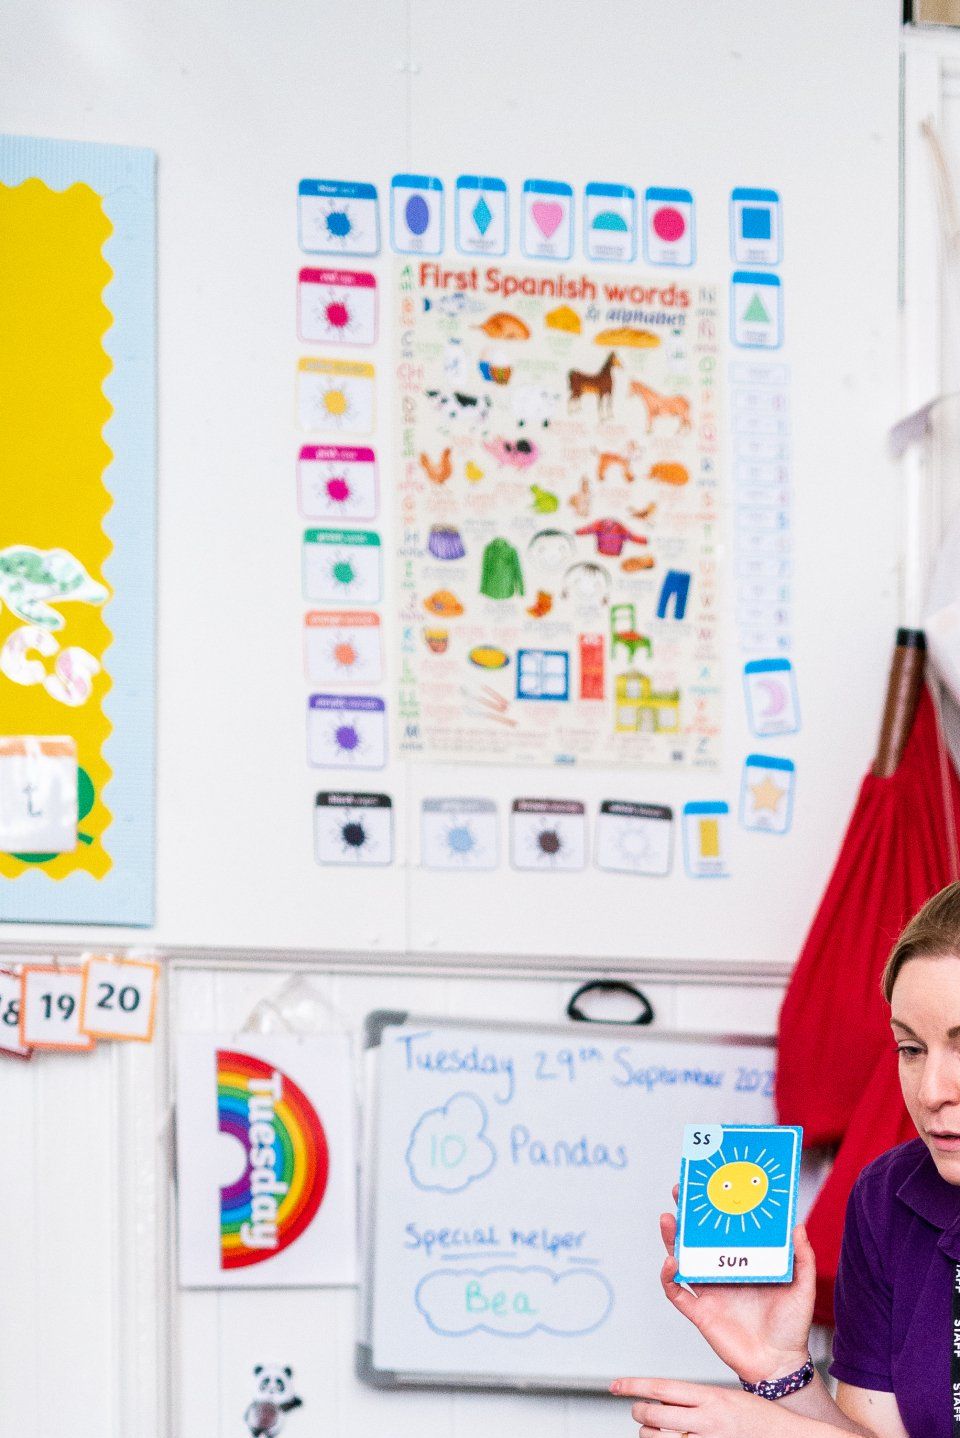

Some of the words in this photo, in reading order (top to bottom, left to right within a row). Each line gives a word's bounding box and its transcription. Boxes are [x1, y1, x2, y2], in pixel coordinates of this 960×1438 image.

[418, 263, 478, 291] First
[485, 267, 597, 299] Spanish
[604, 283, 690, 308] words
[0, 995, 19, 1026] 8
[41, 992, 76, 1021] 19
[97, 983, 141, 1012] 20
[396, 1031, 515, 1104] Tuesday
[735, 1065, 776, 1097] 202
[430, 1133, 467, 1168] 10
[511, 1124, 628, 1169] Pandas
[692, 1131, 712, 1145] Ss
[240, 1071, 288, 1249] Tuesday
[404, 1222, 500, 1256] Special
[510, 1228, 587, 1257] helper
[718, 1255, 748, 1267] sun
[464, 1280, 537, 1317] Bea
